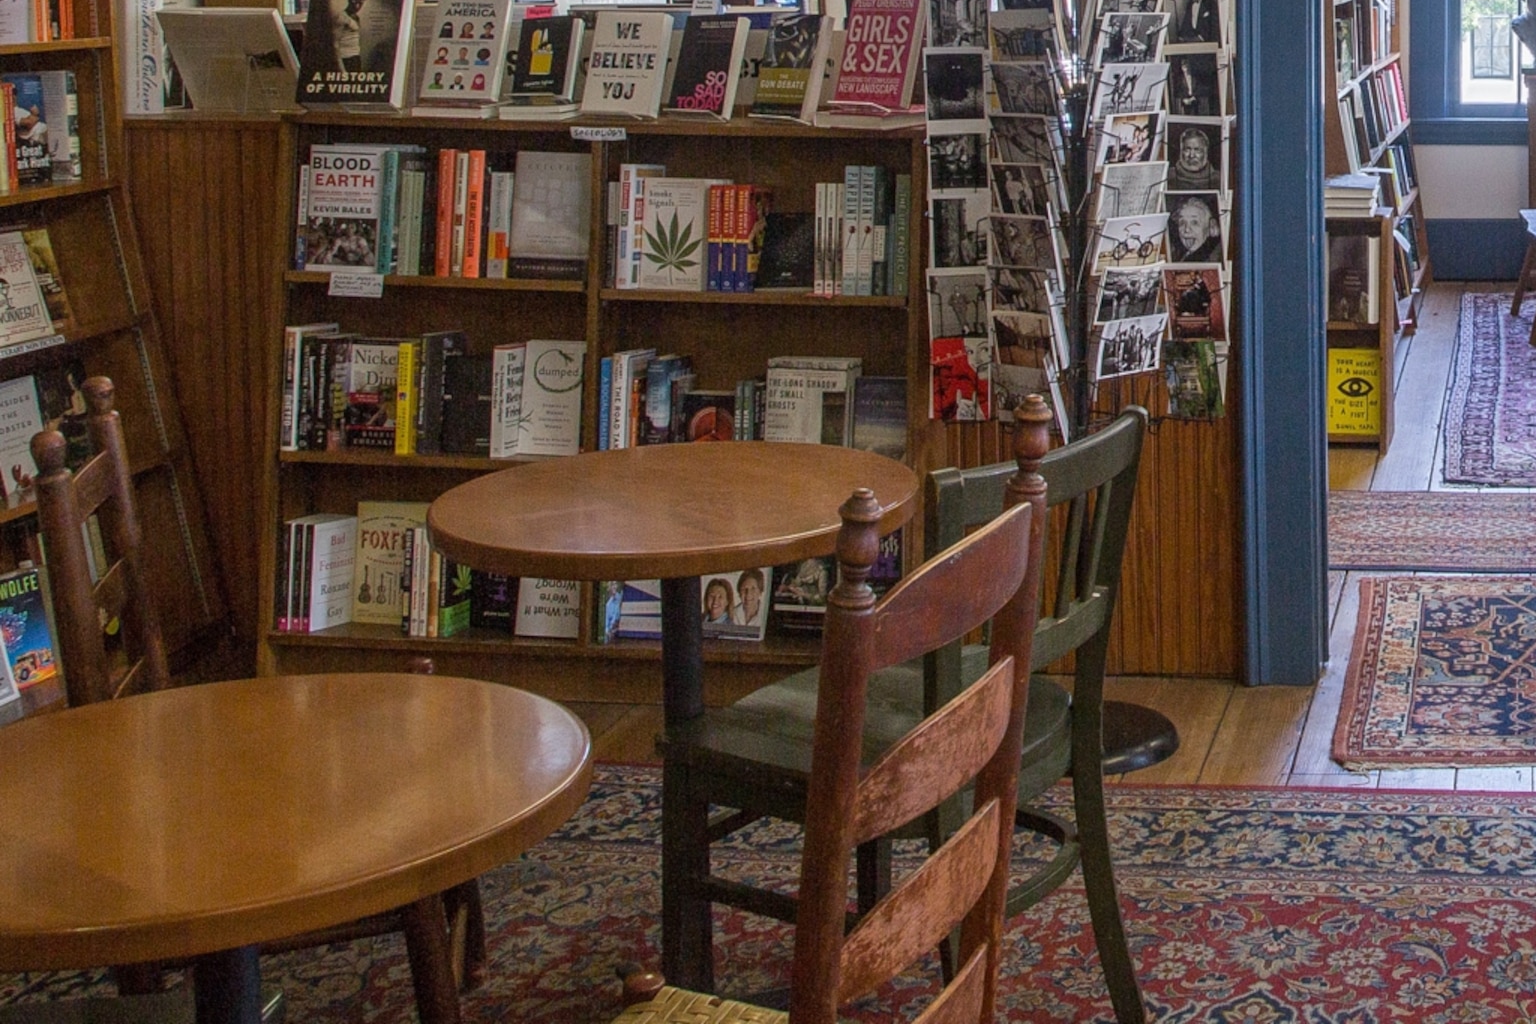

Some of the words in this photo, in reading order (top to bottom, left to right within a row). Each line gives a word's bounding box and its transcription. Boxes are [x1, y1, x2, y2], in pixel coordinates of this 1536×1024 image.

[444, 7, 498, 18] AMERICA
[616, 22, 643, 41] WE
[848, 14, 911, 44] GIRLS
[590, 51, 657, 70] BELIEVE
[842, 43, 858, 73] &
[860, 43, 906, 74] SEX
[312, 71, 322, 82] A
[325, 71, 386, 82] HISTORY
[705, 70, 727, 87] SO
[306, 83, 326, 94] OF
[328, 83, 389, 94] VIRILITY
[694, 83, 725, 99] SAD
[838, 82, 856, 93] NEW
[856, 82, 899, 95] LANDSCAPE
[676, 95, 723, 111] TODAY
[573, 127, 625, 138] SOCIOLOGY
[312, 156, 372, 171] BLOOD
[315, 172, 376, 188] EARTH
[846, 172, 859, 221] PINPOINT
[862, 172, 874, 221] PINPOINT
[313, 205, 341, 214] KEVIN
[353, 350, 397, 365] Nicke
[537, 366, 580, 379] dumped
[614, 387, 622, 402] THE
[613, 406, 621, 430] ROAD
[330, 533, 347, 547] Bad
[319, 555, 354, 572] Feminist
[319, 582, 350, 596] Roxane
[535, 578, 577, 591] Wrong?
[539, 593, 570, 605] We're
[326, 606, 344, 618] Gay
[533, 606, 561, 617] What
